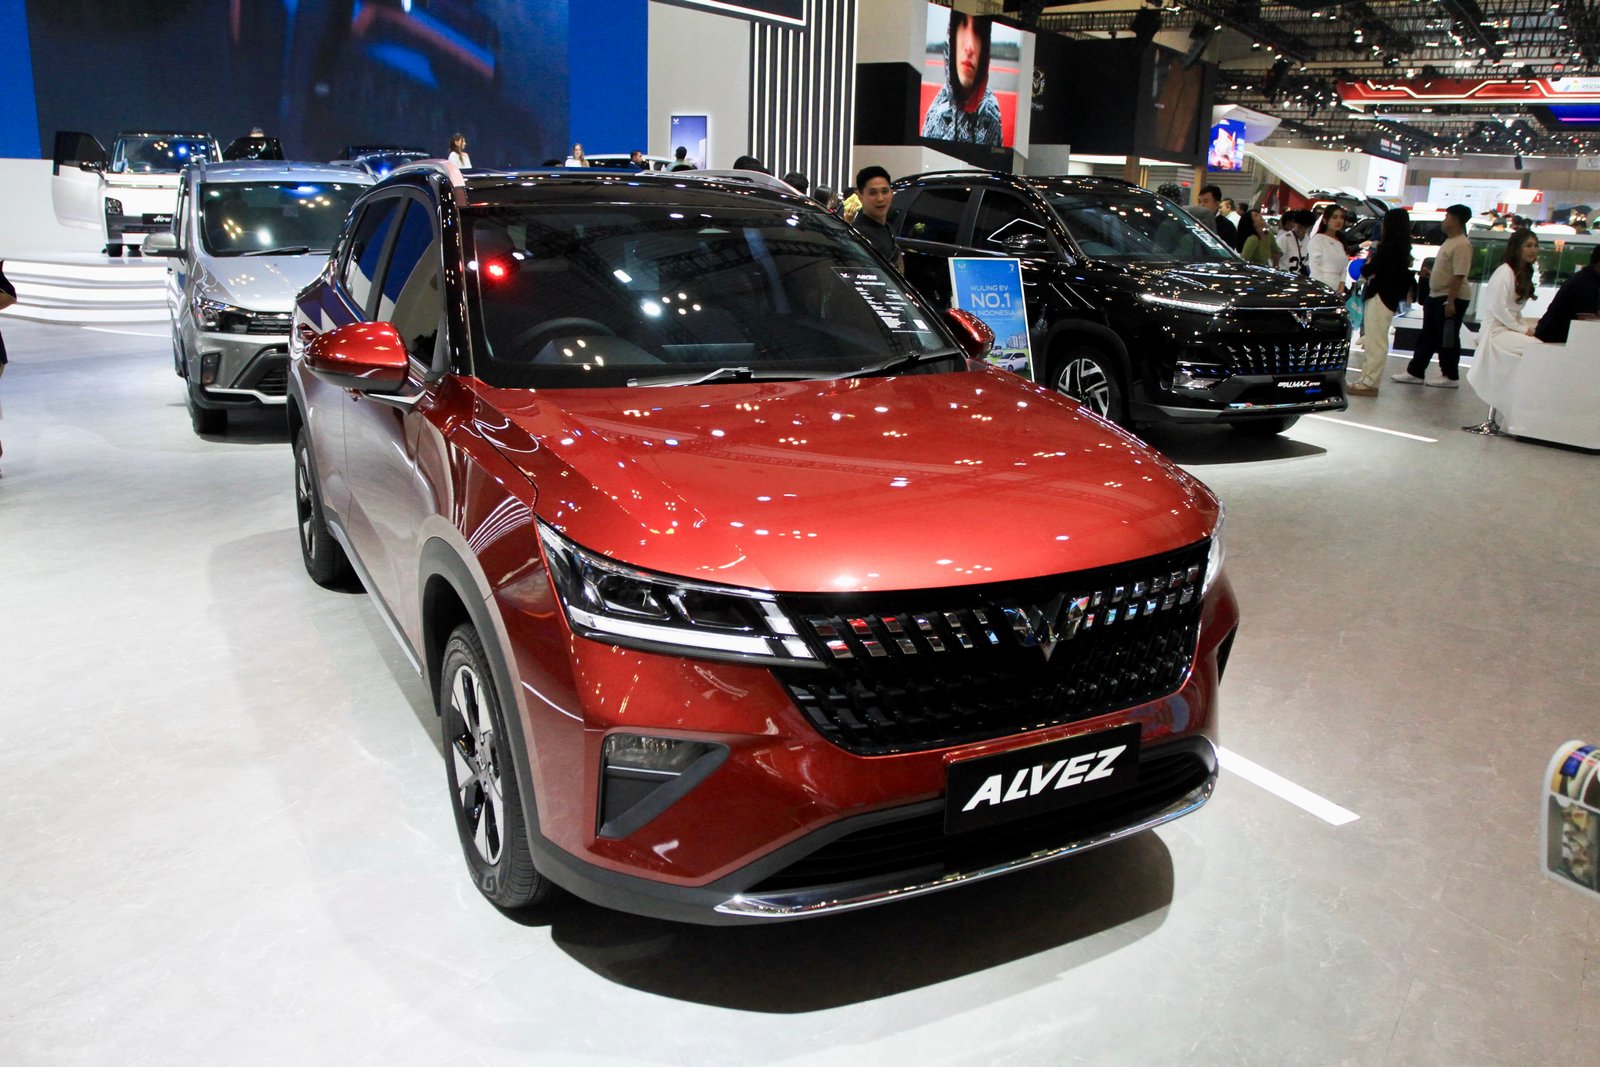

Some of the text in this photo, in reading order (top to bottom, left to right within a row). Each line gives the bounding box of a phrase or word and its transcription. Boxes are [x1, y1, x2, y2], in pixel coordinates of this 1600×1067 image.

[999, 284, 1009, 292] EV
[970, 292, 1011, 308] NO.1
[977, 310, 1016, 318] INDONESIA
[962, 745, 1127, 812] ALVEZ
